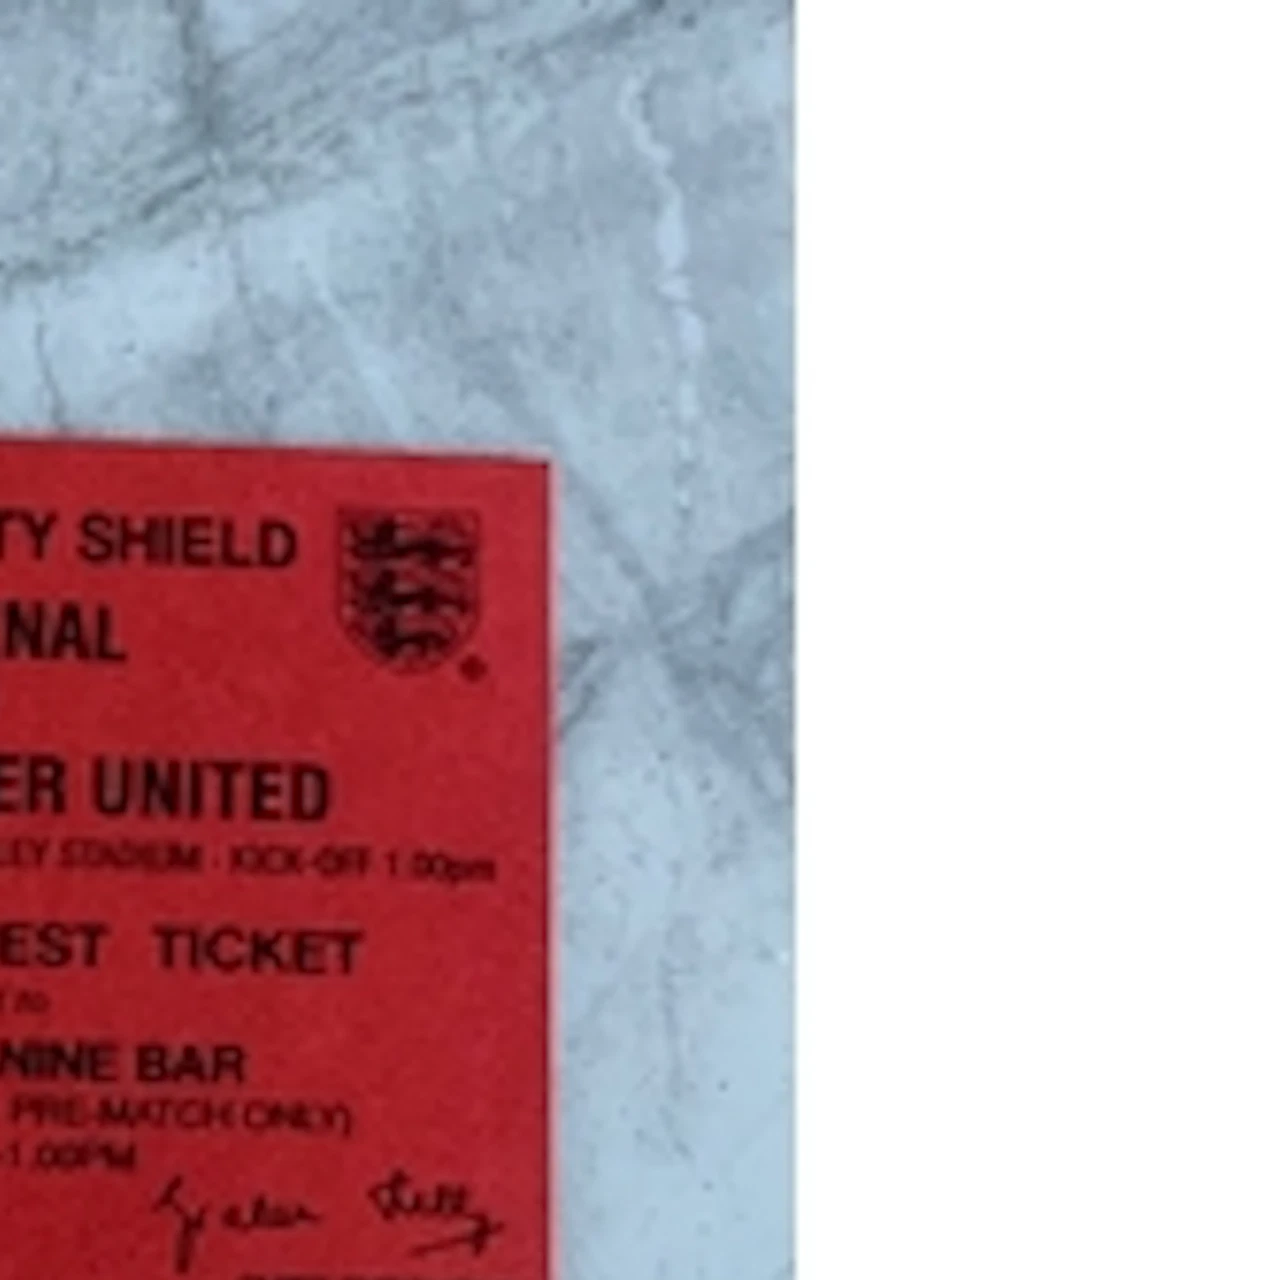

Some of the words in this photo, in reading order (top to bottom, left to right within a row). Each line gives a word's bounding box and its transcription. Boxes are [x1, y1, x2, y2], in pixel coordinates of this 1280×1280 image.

[77, 511, 298, 569] SHIELD
[93, 757, 330, 823] UNITED
[60, 839, 203, 873] STADIUM
[229, 844, 371, 878] KICK-OFF
[153, 924, 362, 975] TICKET
[135, 1043, 246, 1084] BAR
[9, 1093, 235, 1130] PRE-MATCH
[241, 1101, 352, 1136] ONLY)
